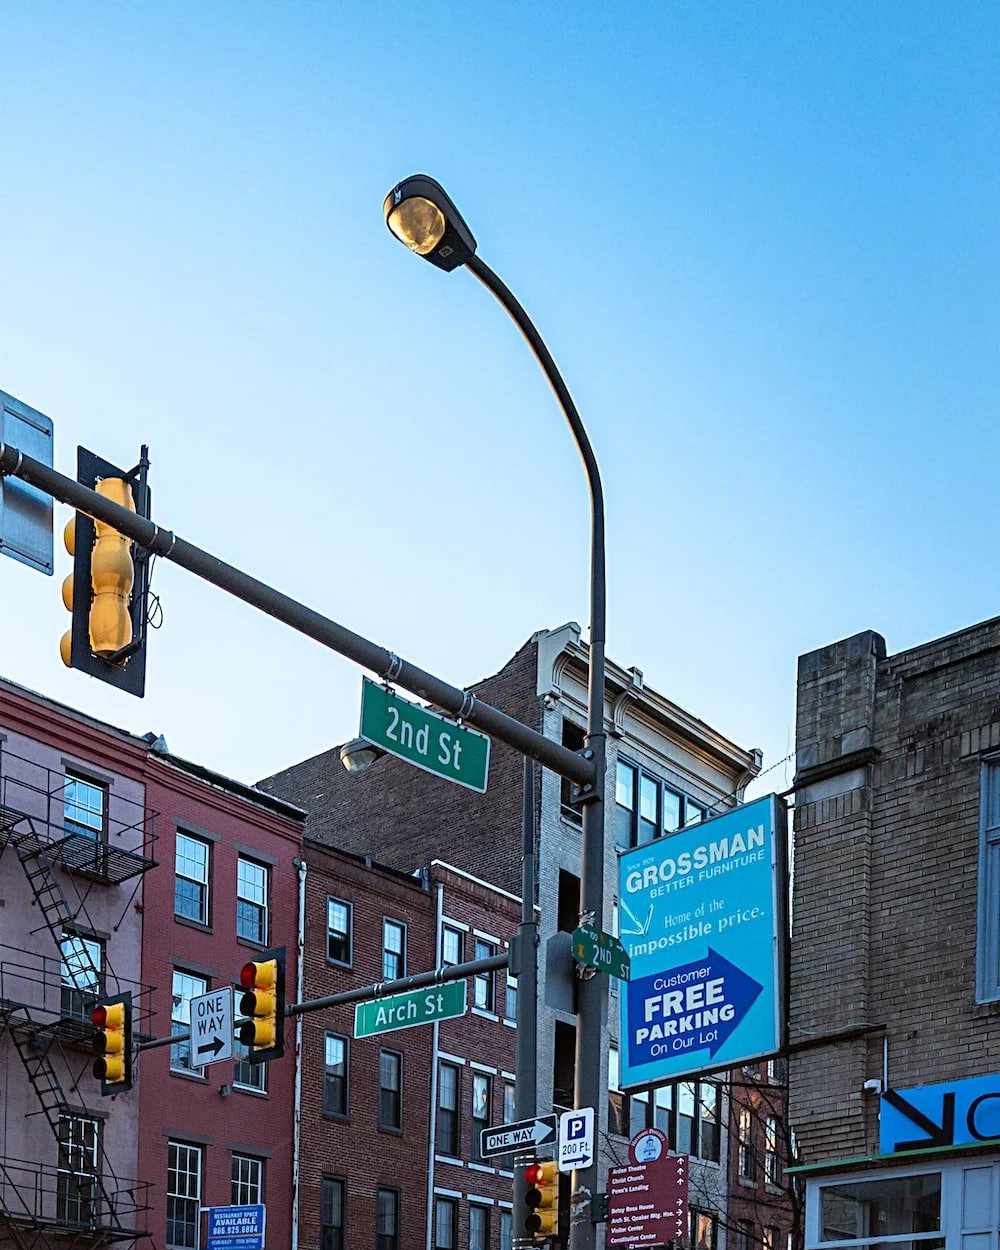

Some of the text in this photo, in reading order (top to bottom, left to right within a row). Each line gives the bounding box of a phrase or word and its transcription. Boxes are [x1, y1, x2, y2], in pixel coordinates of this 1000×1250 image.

[386, 706, 462, 771] 2nd St
[625, 824, 765, 894] GROSSMAN
[650, 849, 765, 899] BETTER FURNITURE
[664, 899, 725, 929] Home of the
[629, 906, 765, 958] impossible price.
[592, 944, 630, 981] 2ND ST
[653, 966, 712, 991] Customer
[197, 996, 224, 1018] ONE
[375, 993, 444, 1027] Arch St
[644, 977, 725, 1023] FREE
[197, 1014, 225, 1036] WAY
[636, 1003, 735, 1045] PARKING
[650, 1028, 718, 1057] On Our Lot
[489, 1128, 534, 1148] ONE WAY
[562, 1142, 591, 1156] 200 Ft.
[612, 1175, 645, 1185] Christ Church
[629, 1184, 650, 1192] Landing
[215, 1217, 257, 1226] AVAILABLE
[610, 1235, 640, 1243] Constitution
